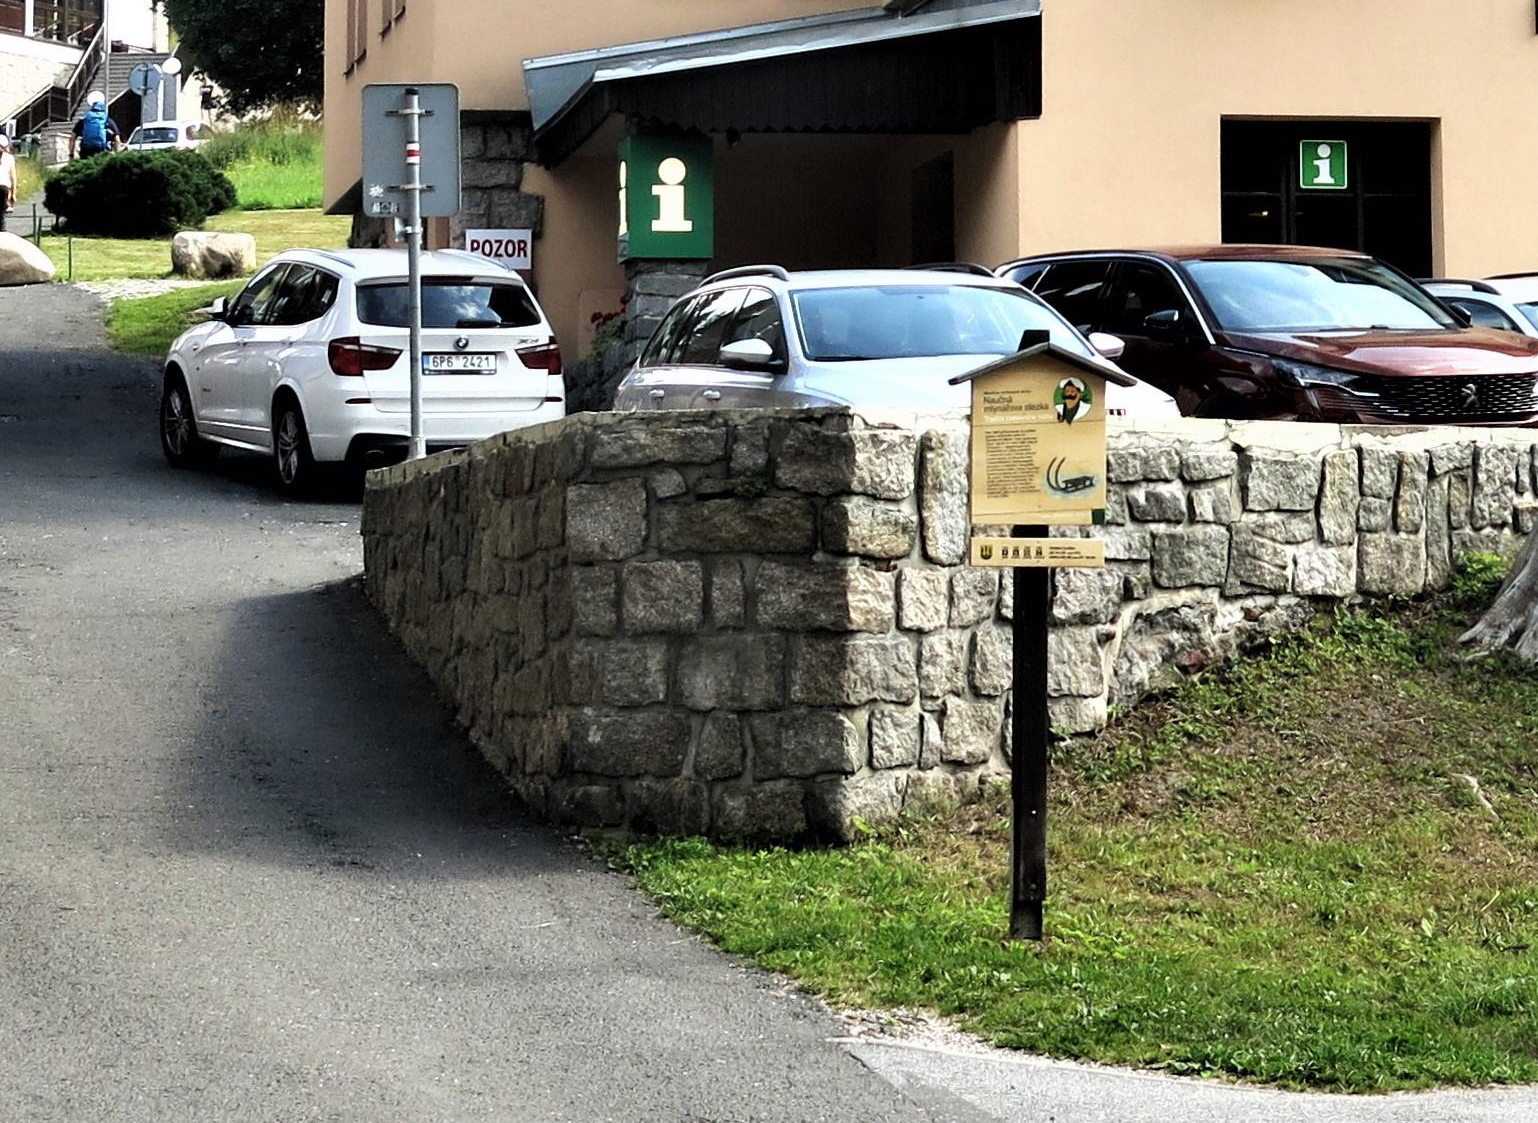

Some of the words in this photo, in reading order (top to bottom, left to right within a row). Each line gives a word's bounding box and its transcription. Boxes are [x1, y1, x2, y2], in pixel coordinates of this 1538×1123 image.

[470, 238, 528, 258] POZOR
[432, 354, 454, 368] 6P6
[462, 354, 490, 368] 2421
